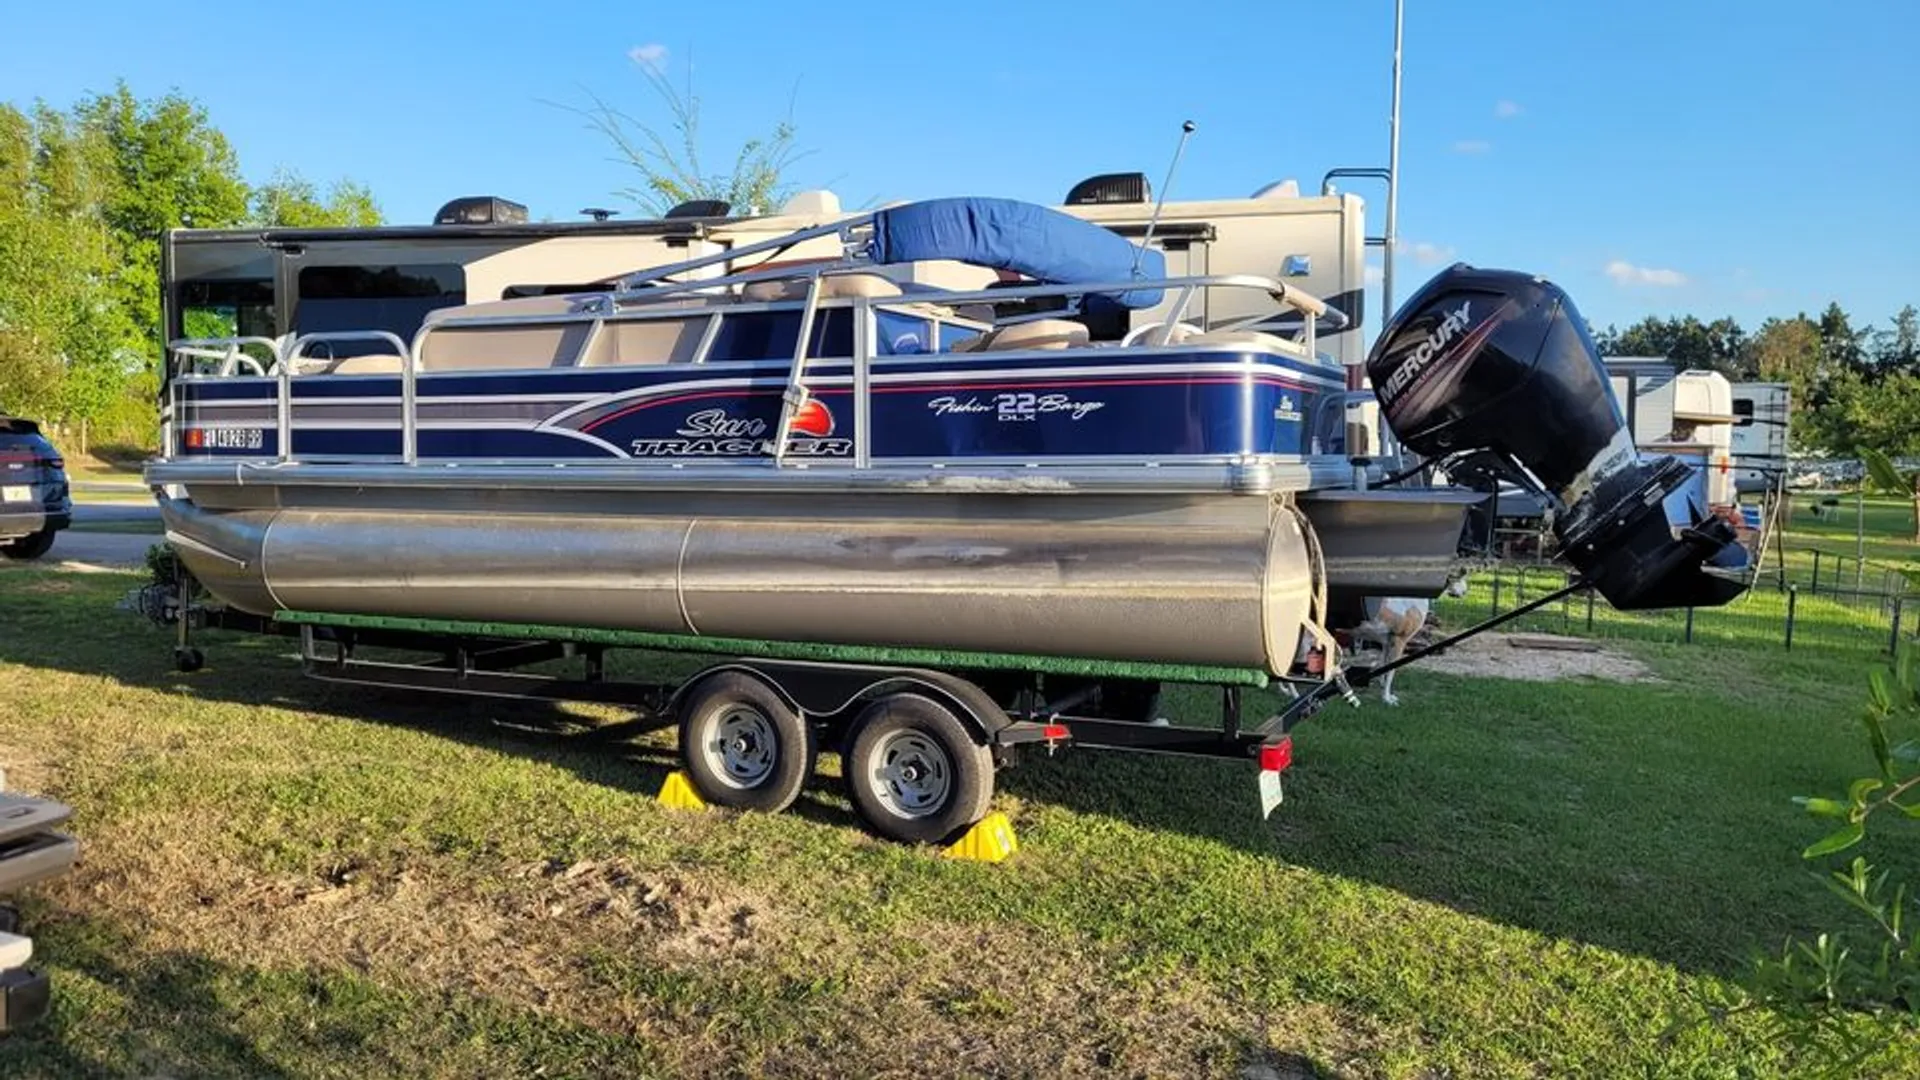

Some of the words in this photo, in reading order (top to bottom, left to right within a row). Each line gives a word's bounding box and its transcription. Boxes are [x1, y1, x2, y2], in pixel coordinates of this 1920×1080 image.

[1379, 300, 1471, 405] MERCURY
[997, 393, 1036, 413] 22
[676, 408, 767, 437] Sun
[997, 414, 1036, 422] DLX
